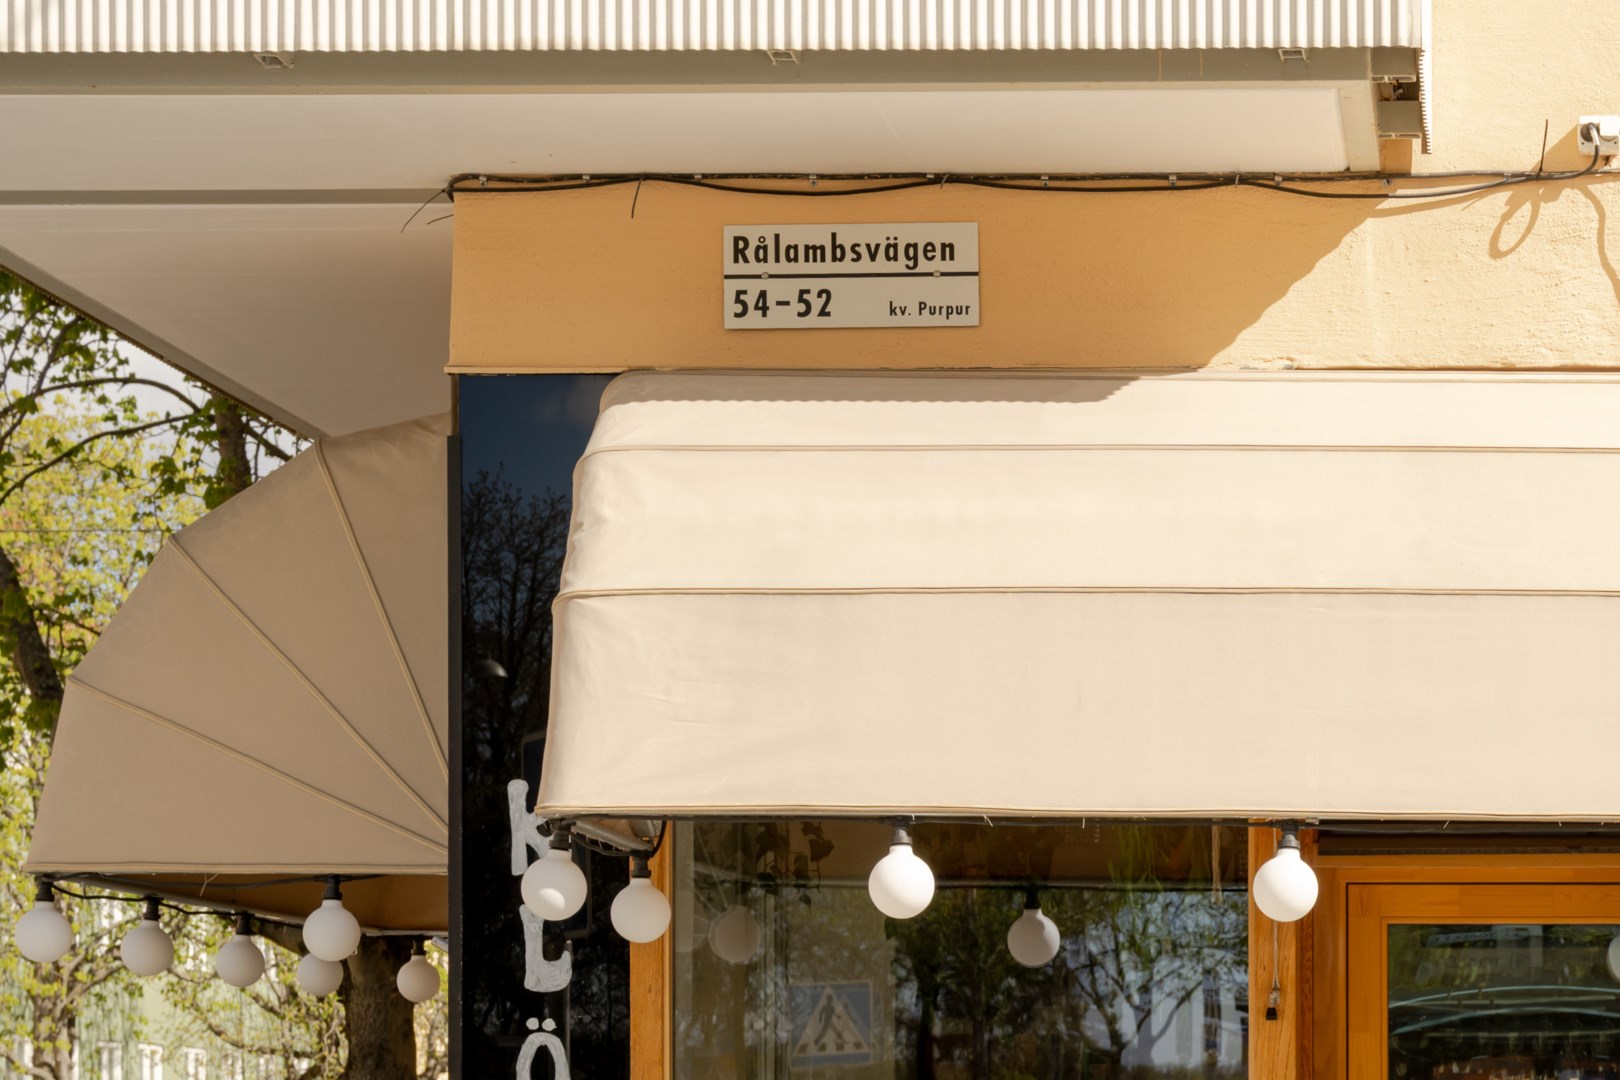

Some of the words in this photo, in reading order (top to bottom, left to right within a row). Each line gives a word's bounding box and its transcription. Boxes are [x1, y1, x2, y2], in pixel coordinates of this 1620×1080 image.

[733, 232, 955, 270] Rålambsvägen
[889, 301, 911, 317] kv.
[918, 301, 971, 320] Purpur
